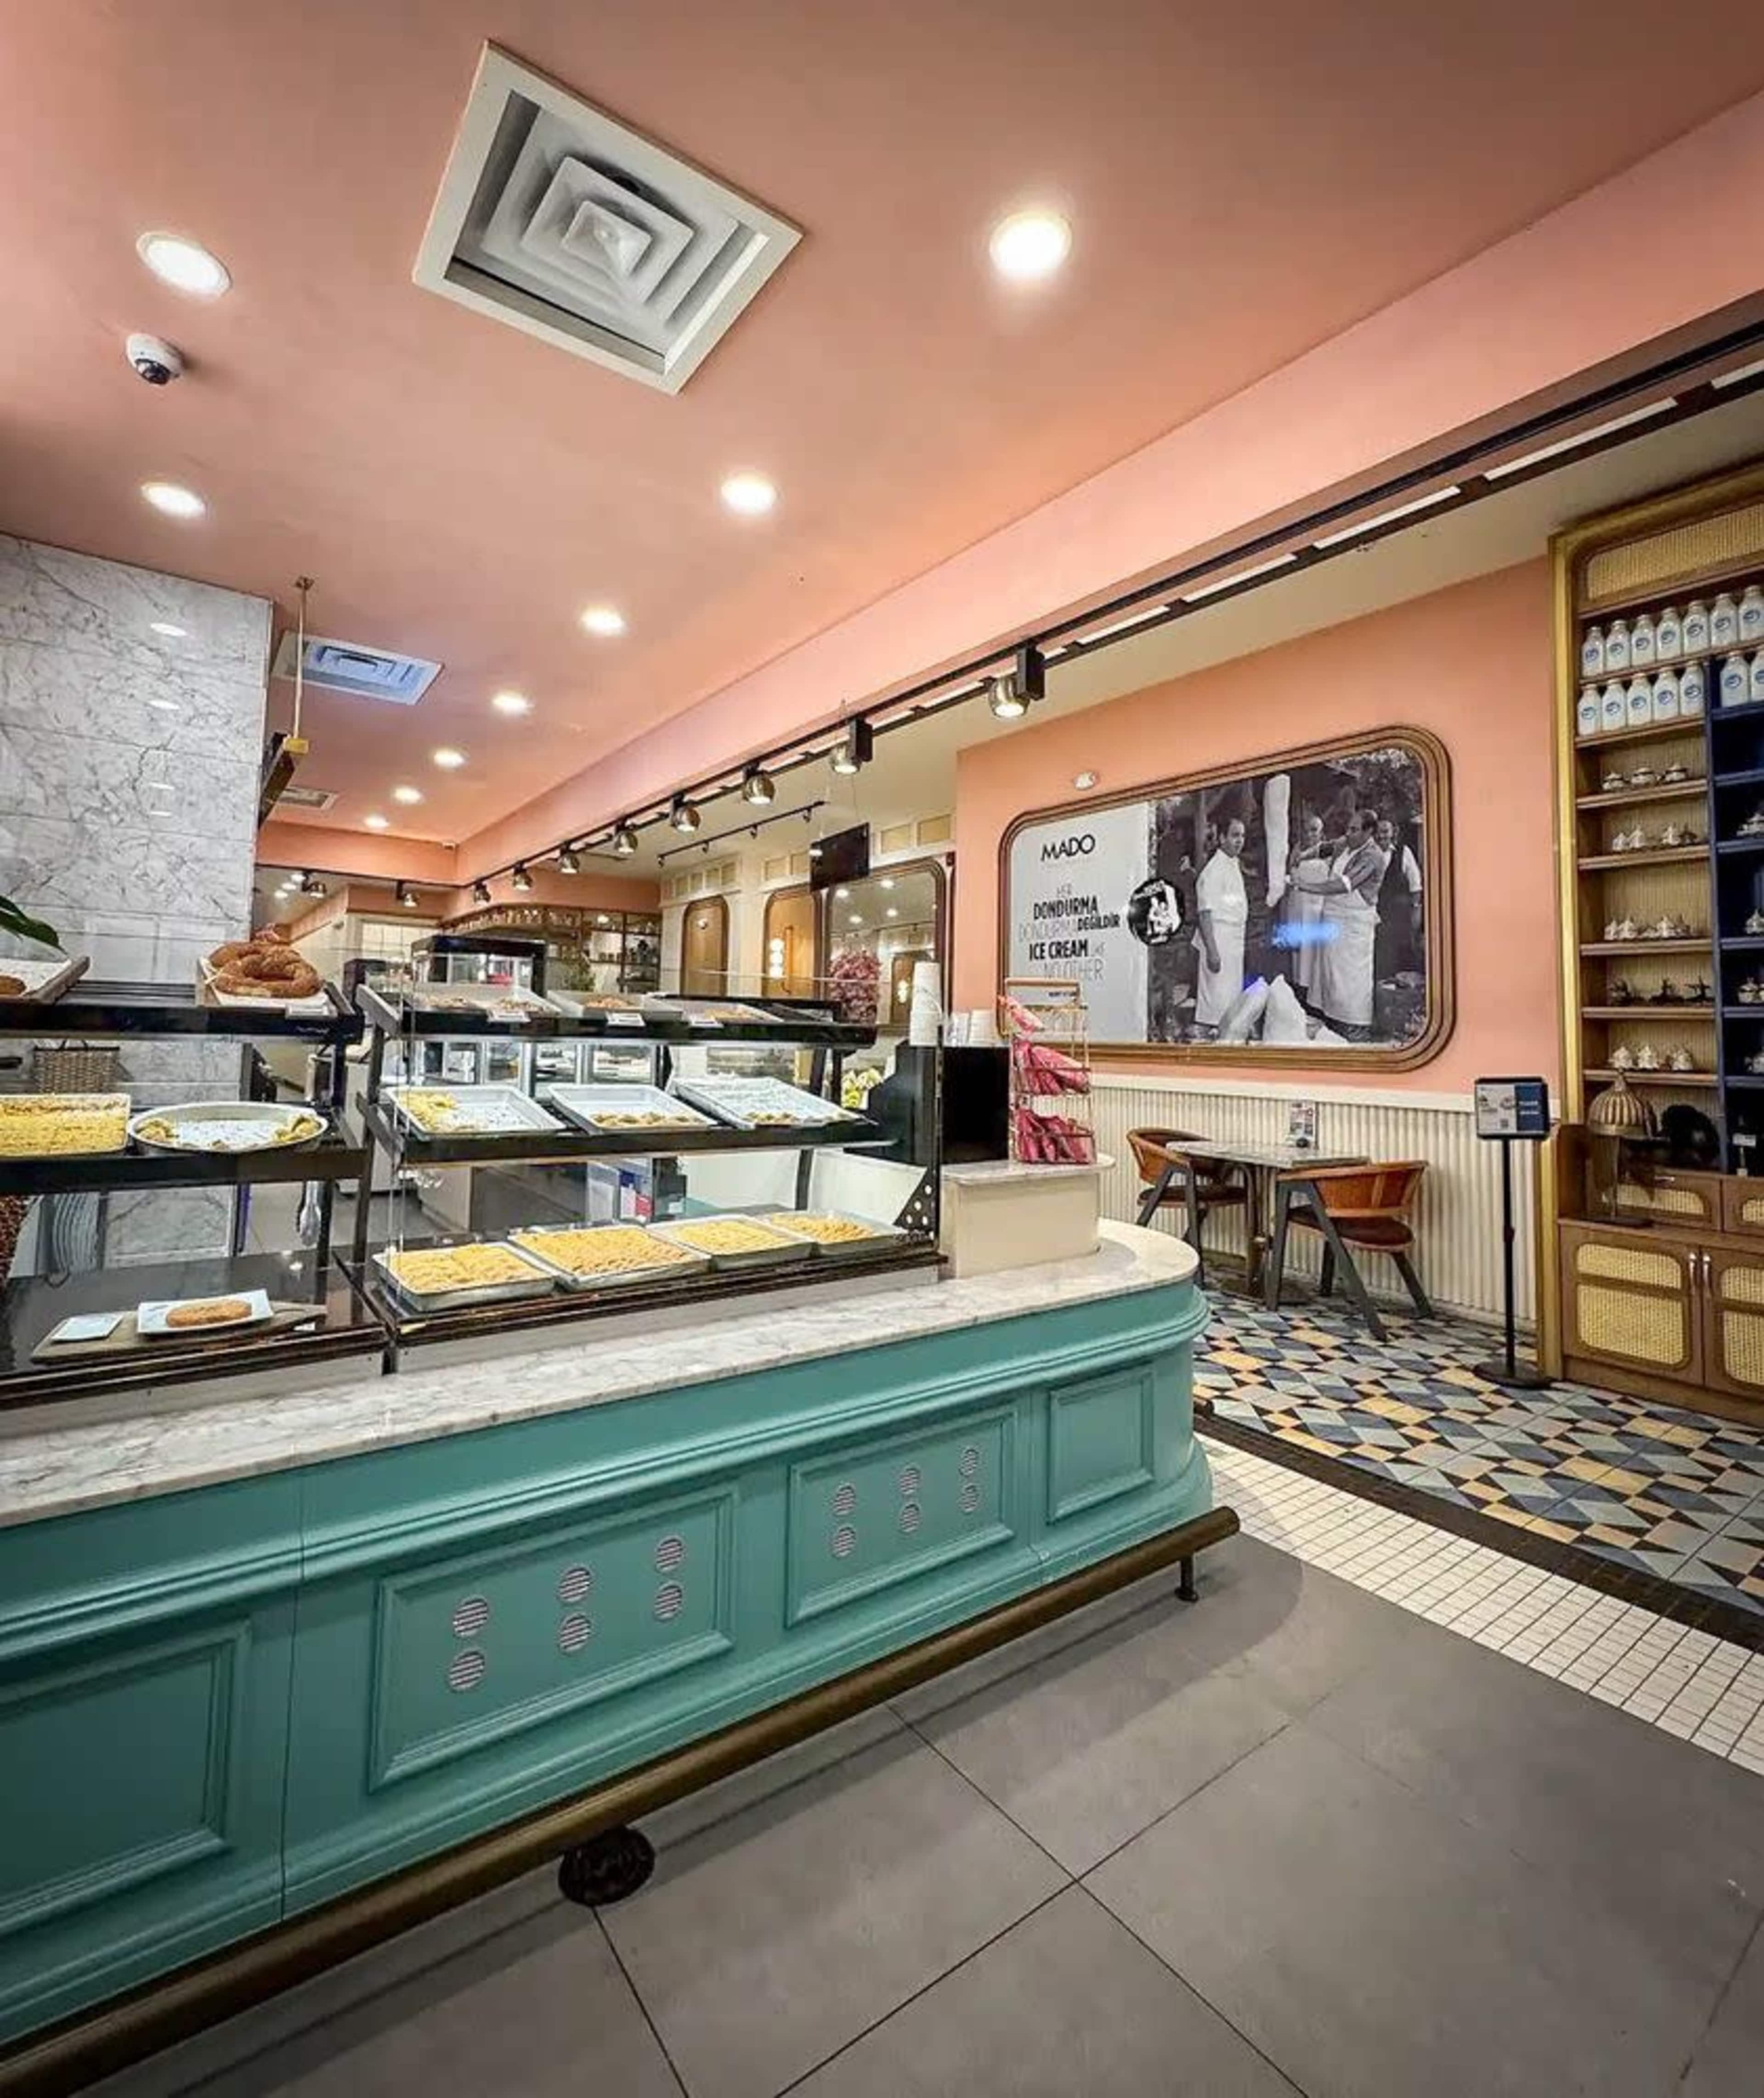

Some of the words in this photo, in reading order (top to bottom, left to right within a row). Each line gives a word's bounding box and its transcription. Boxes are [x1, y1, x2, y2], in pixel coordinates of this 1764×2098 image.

[1040, 834, 1096, 862] MADO
[1034, 895, 1098, 920] DONDURMA
[1029, 942, 1045, 961] ICE
[1048, 939, 1088, 959] CREAM
